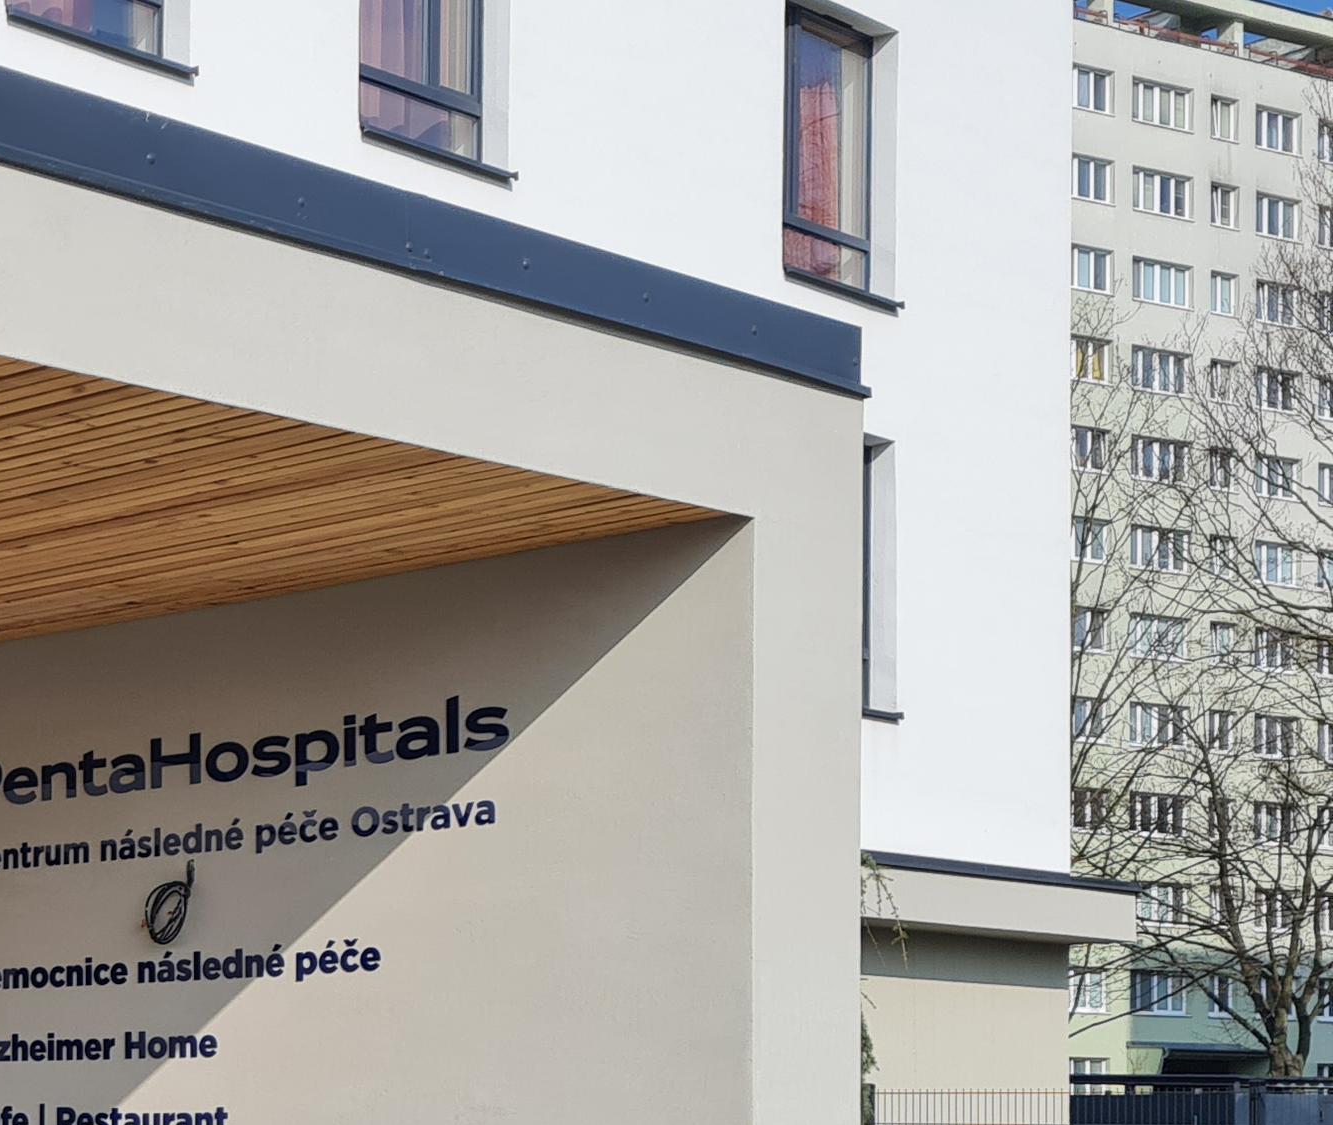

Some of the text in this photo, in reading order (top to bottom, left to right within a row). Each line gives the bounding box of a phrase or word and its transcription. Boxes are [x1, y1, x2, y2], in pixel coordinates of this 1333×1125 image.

[99, 818, 244, 863] následné
[255, 810, 338, 853] péče
[351, 799, 496, 837] Ostrava
[137, 944, 285, 983] následné
[295, 938, 381, 982] péče
[124, 1031, 217, 1060] Home
